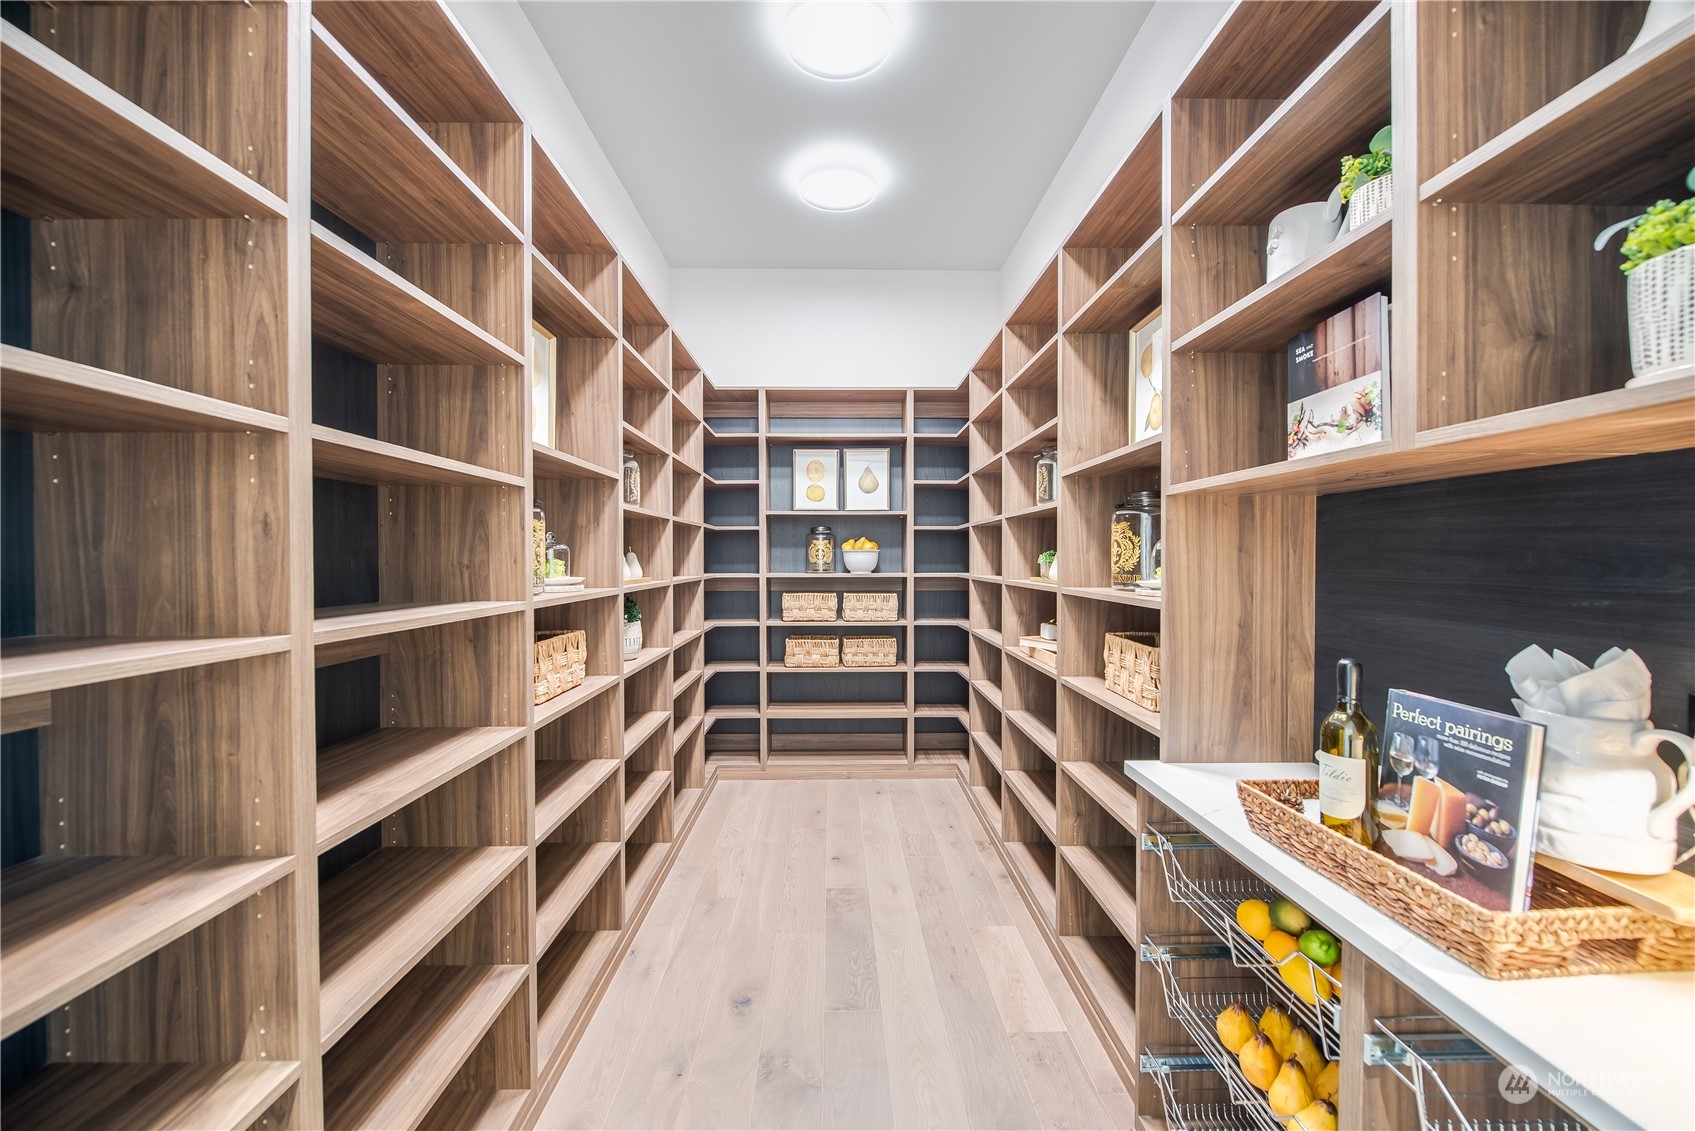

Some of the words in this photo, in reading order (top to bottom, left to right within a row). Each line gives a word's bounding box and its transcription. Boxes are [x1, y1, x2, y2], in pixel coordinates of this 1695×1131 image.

[1295, 346, 1306, 355] SEA
[1295, 350, 1314, 364] SMOKE
[1392, 702, 1442, 731] Perfect
[1444, 721, 1514, 752] pairings
